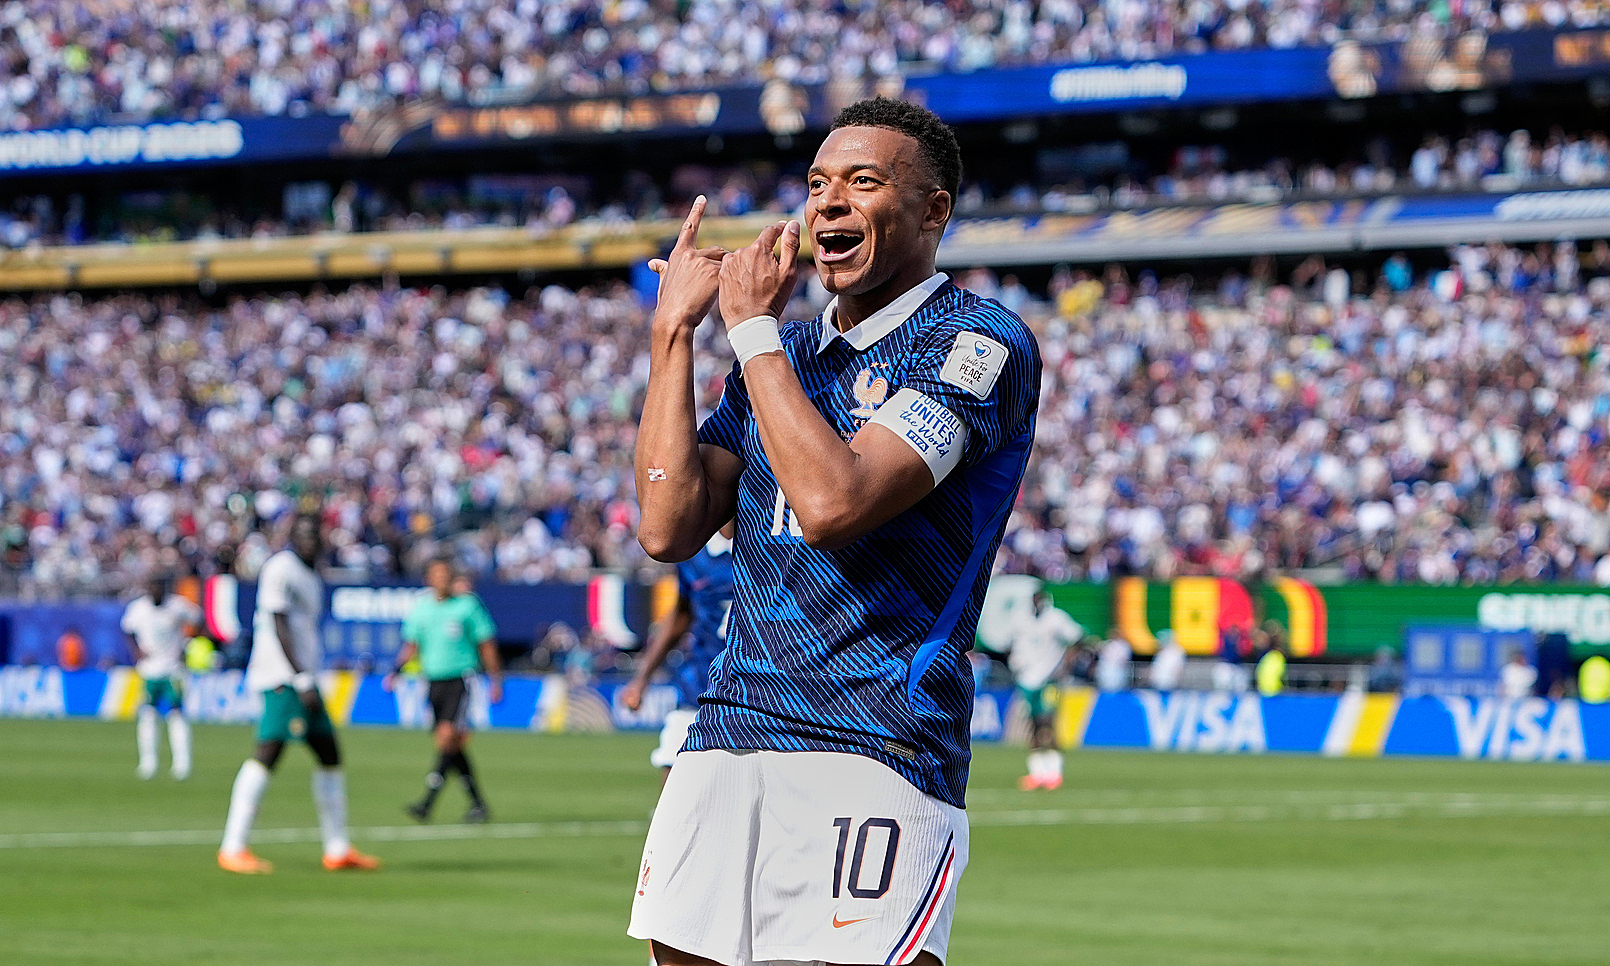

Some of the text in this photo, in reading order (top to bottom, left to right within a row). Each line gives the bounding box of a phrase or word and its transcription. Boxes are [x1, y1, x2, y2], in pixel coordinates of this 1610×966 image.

[959, 363, 984, 383] PEACE
[960, 375, 973, 386] FIFA
[900, 410, 949, 459] the World
[910, 400, 955, 446] UNITES
[919, 394, 961, 435] FOOTBALL
[907, 431, 928, 451] FIFA
[1134, 689, 1269, 753] VISA
[1443, 696, 1587, 761] VISA
[832, 816, 902, 899] 10
